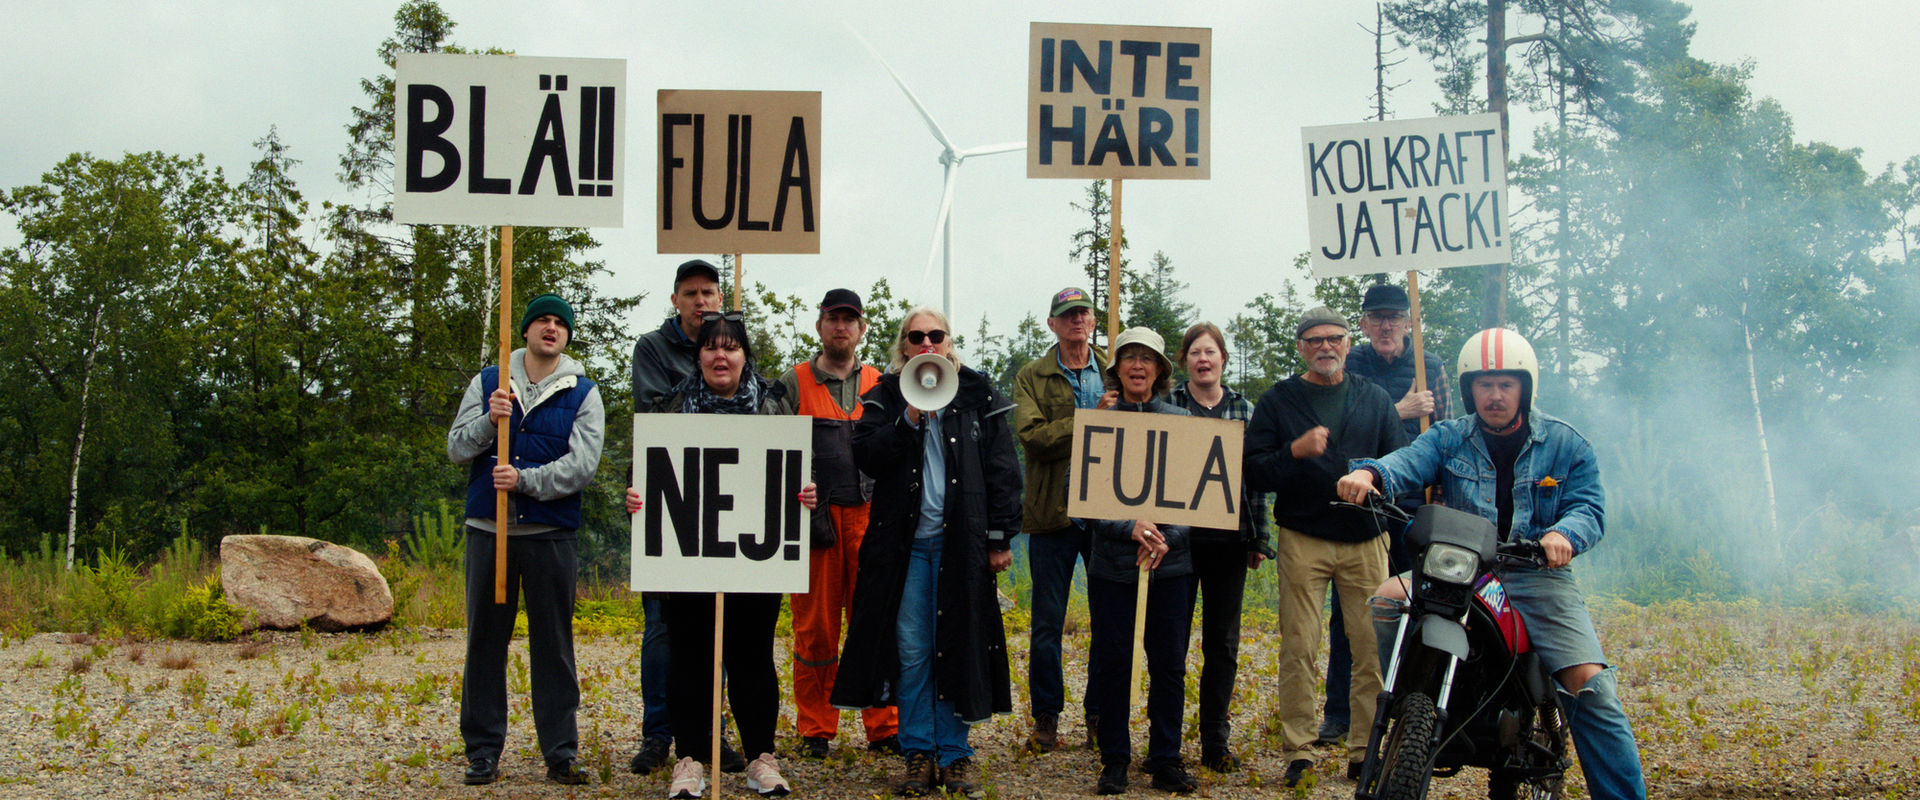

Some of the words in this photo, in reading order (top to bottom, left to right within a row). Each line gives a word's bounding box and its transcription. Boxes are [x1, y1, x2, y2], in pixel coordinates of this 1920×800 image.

[1040, 38, 1200, 101] INTE
[406, 74, 615, 196] BLÄ!!
[663, 113, 815, 232] FULA
[1039, 98, 1199, 166] HÄR!
[1308, 129, 1495, 196] KOLKRAFT
[645, 447, 803, 561] NEJ!
[1079, 425, 1235, 514] FULA
